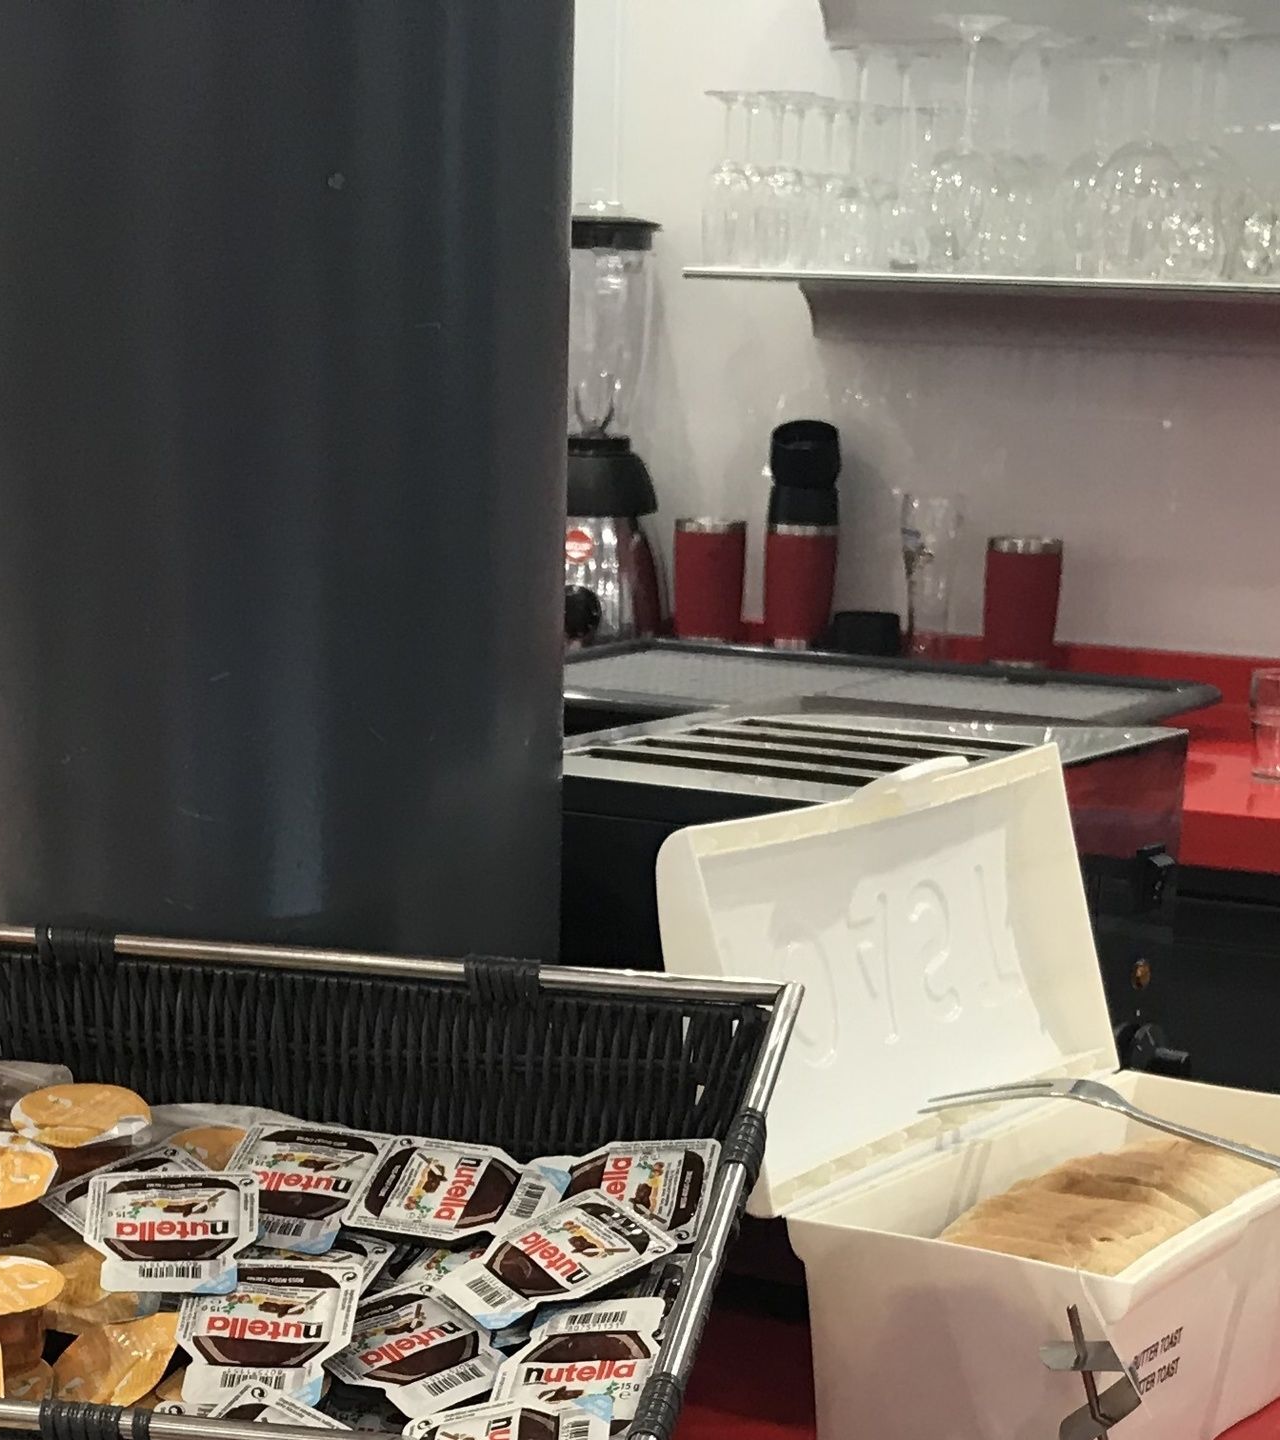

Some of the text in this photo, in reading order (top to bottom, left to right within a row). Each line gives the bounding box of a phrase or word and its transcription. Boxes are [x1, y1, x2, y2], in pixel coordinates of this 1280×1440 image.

[432, 1156, 484, 1222] nutella
[604, 1156, 634, 1201] ella
[115, 1218, 229, 1242] nutella
[519, 1230, 590, 1286] nutella
[206, 1315, 324, 1342] nutella
[1160, 1326, 1183, 1353] TOAST
[357, 1320, 463, 1368] nutella
[523, 1360, 637, 1385] nutella
[1156, 1356, 1181, 1384] TOAST
[620, 1382, 631, 1390] 15
